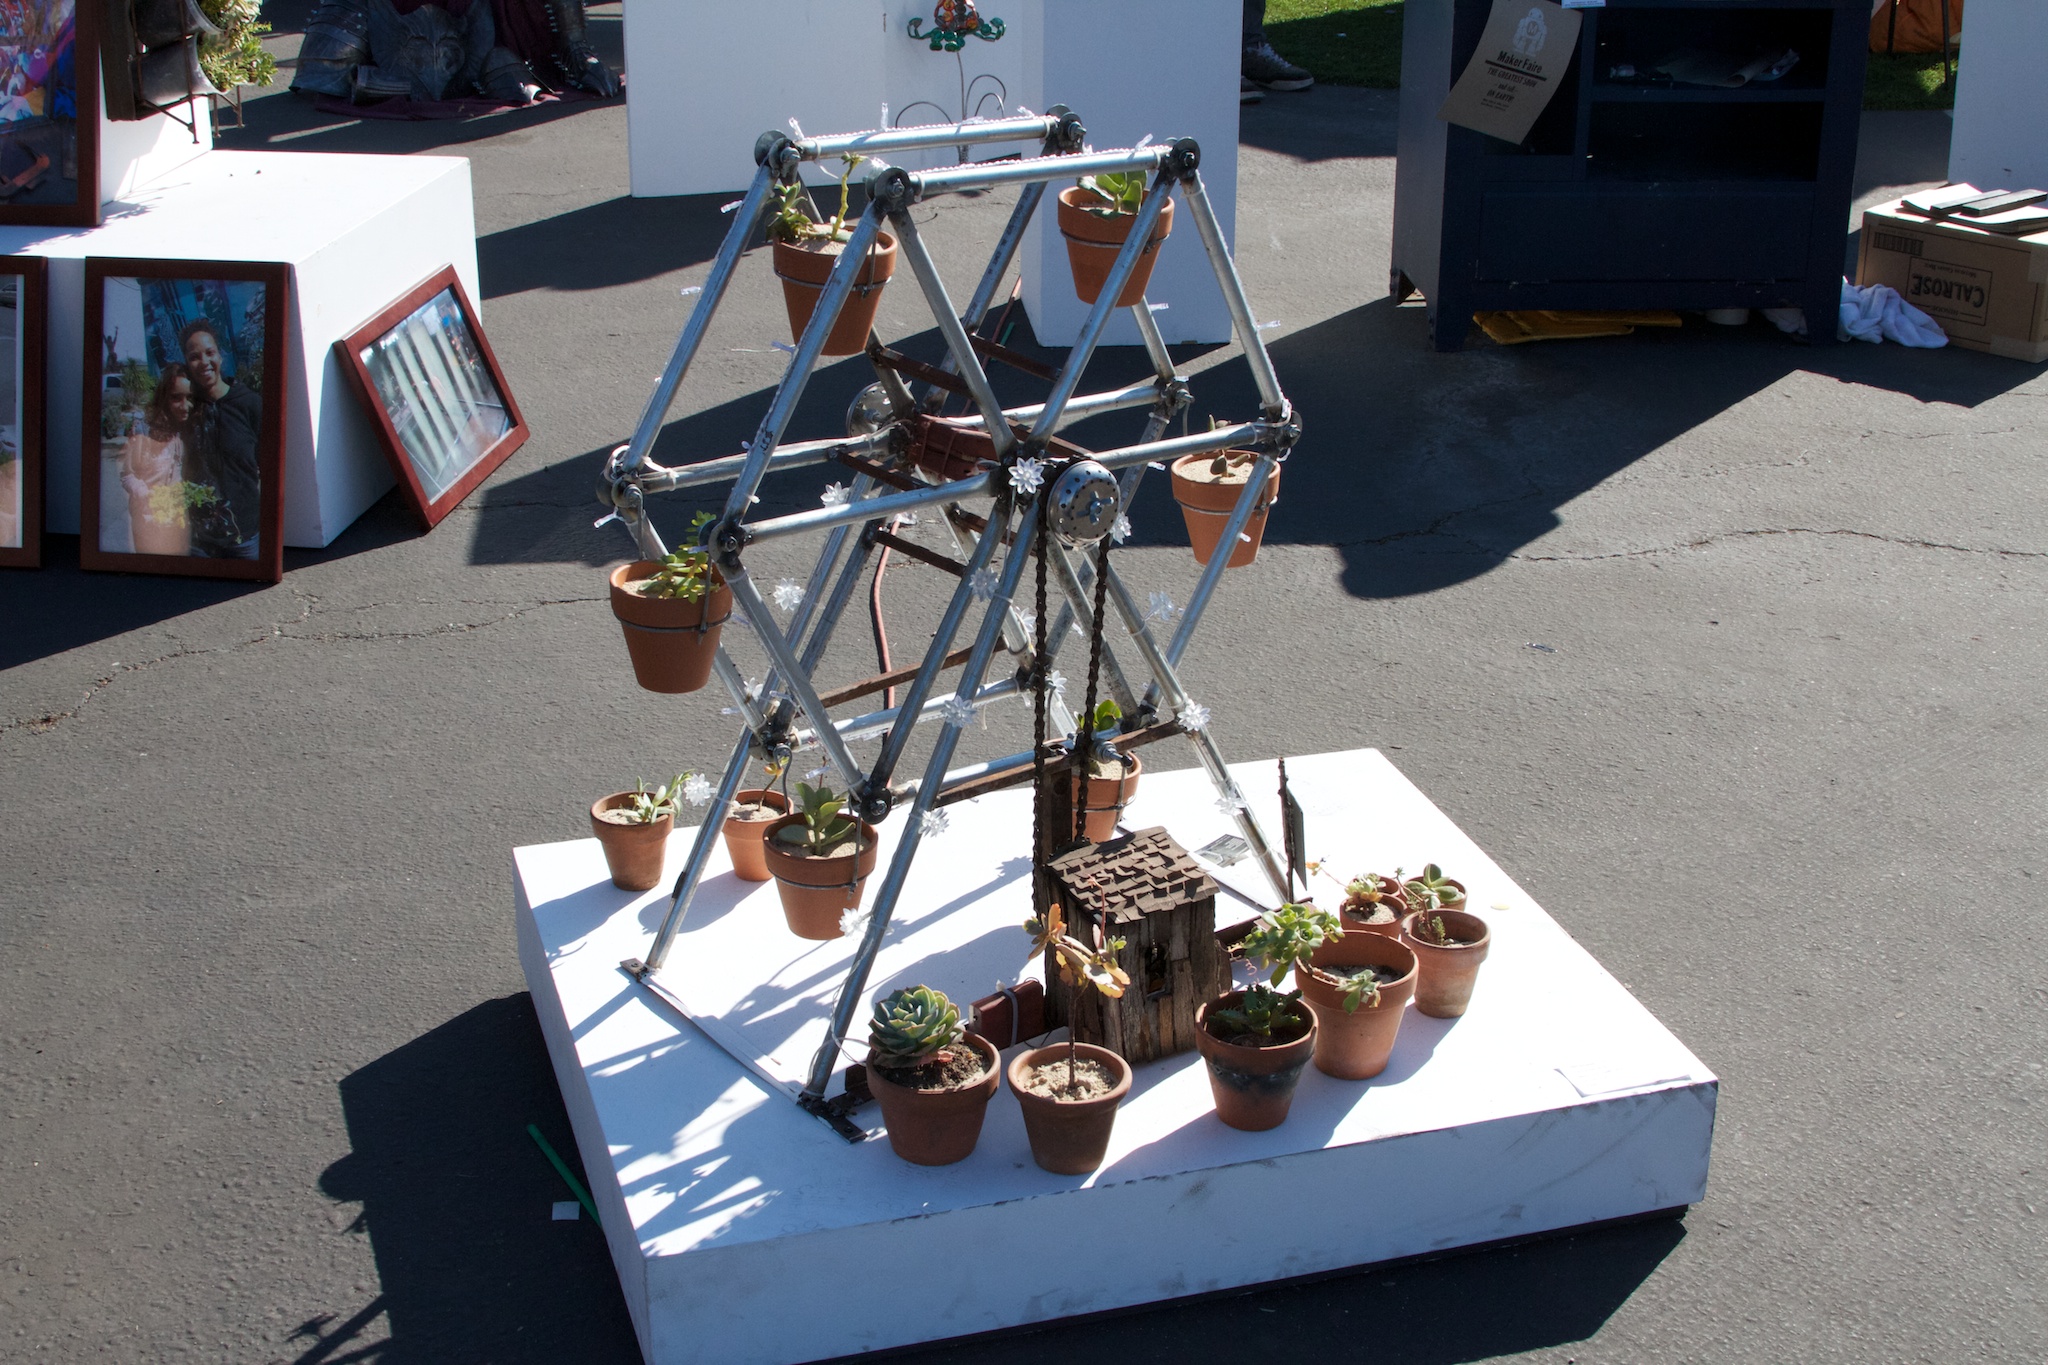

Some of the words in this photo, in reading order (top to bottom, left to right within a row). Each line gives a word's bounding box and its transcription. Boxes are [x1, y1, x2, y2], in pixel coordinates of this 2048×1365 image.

[1497, 50, 1522, 67] Maker
[1522, 58, 1543, 74] Faire
[1498, 70, 1524, 84] GREATEST
[1910, 273, 1985, 308] CALROSE
